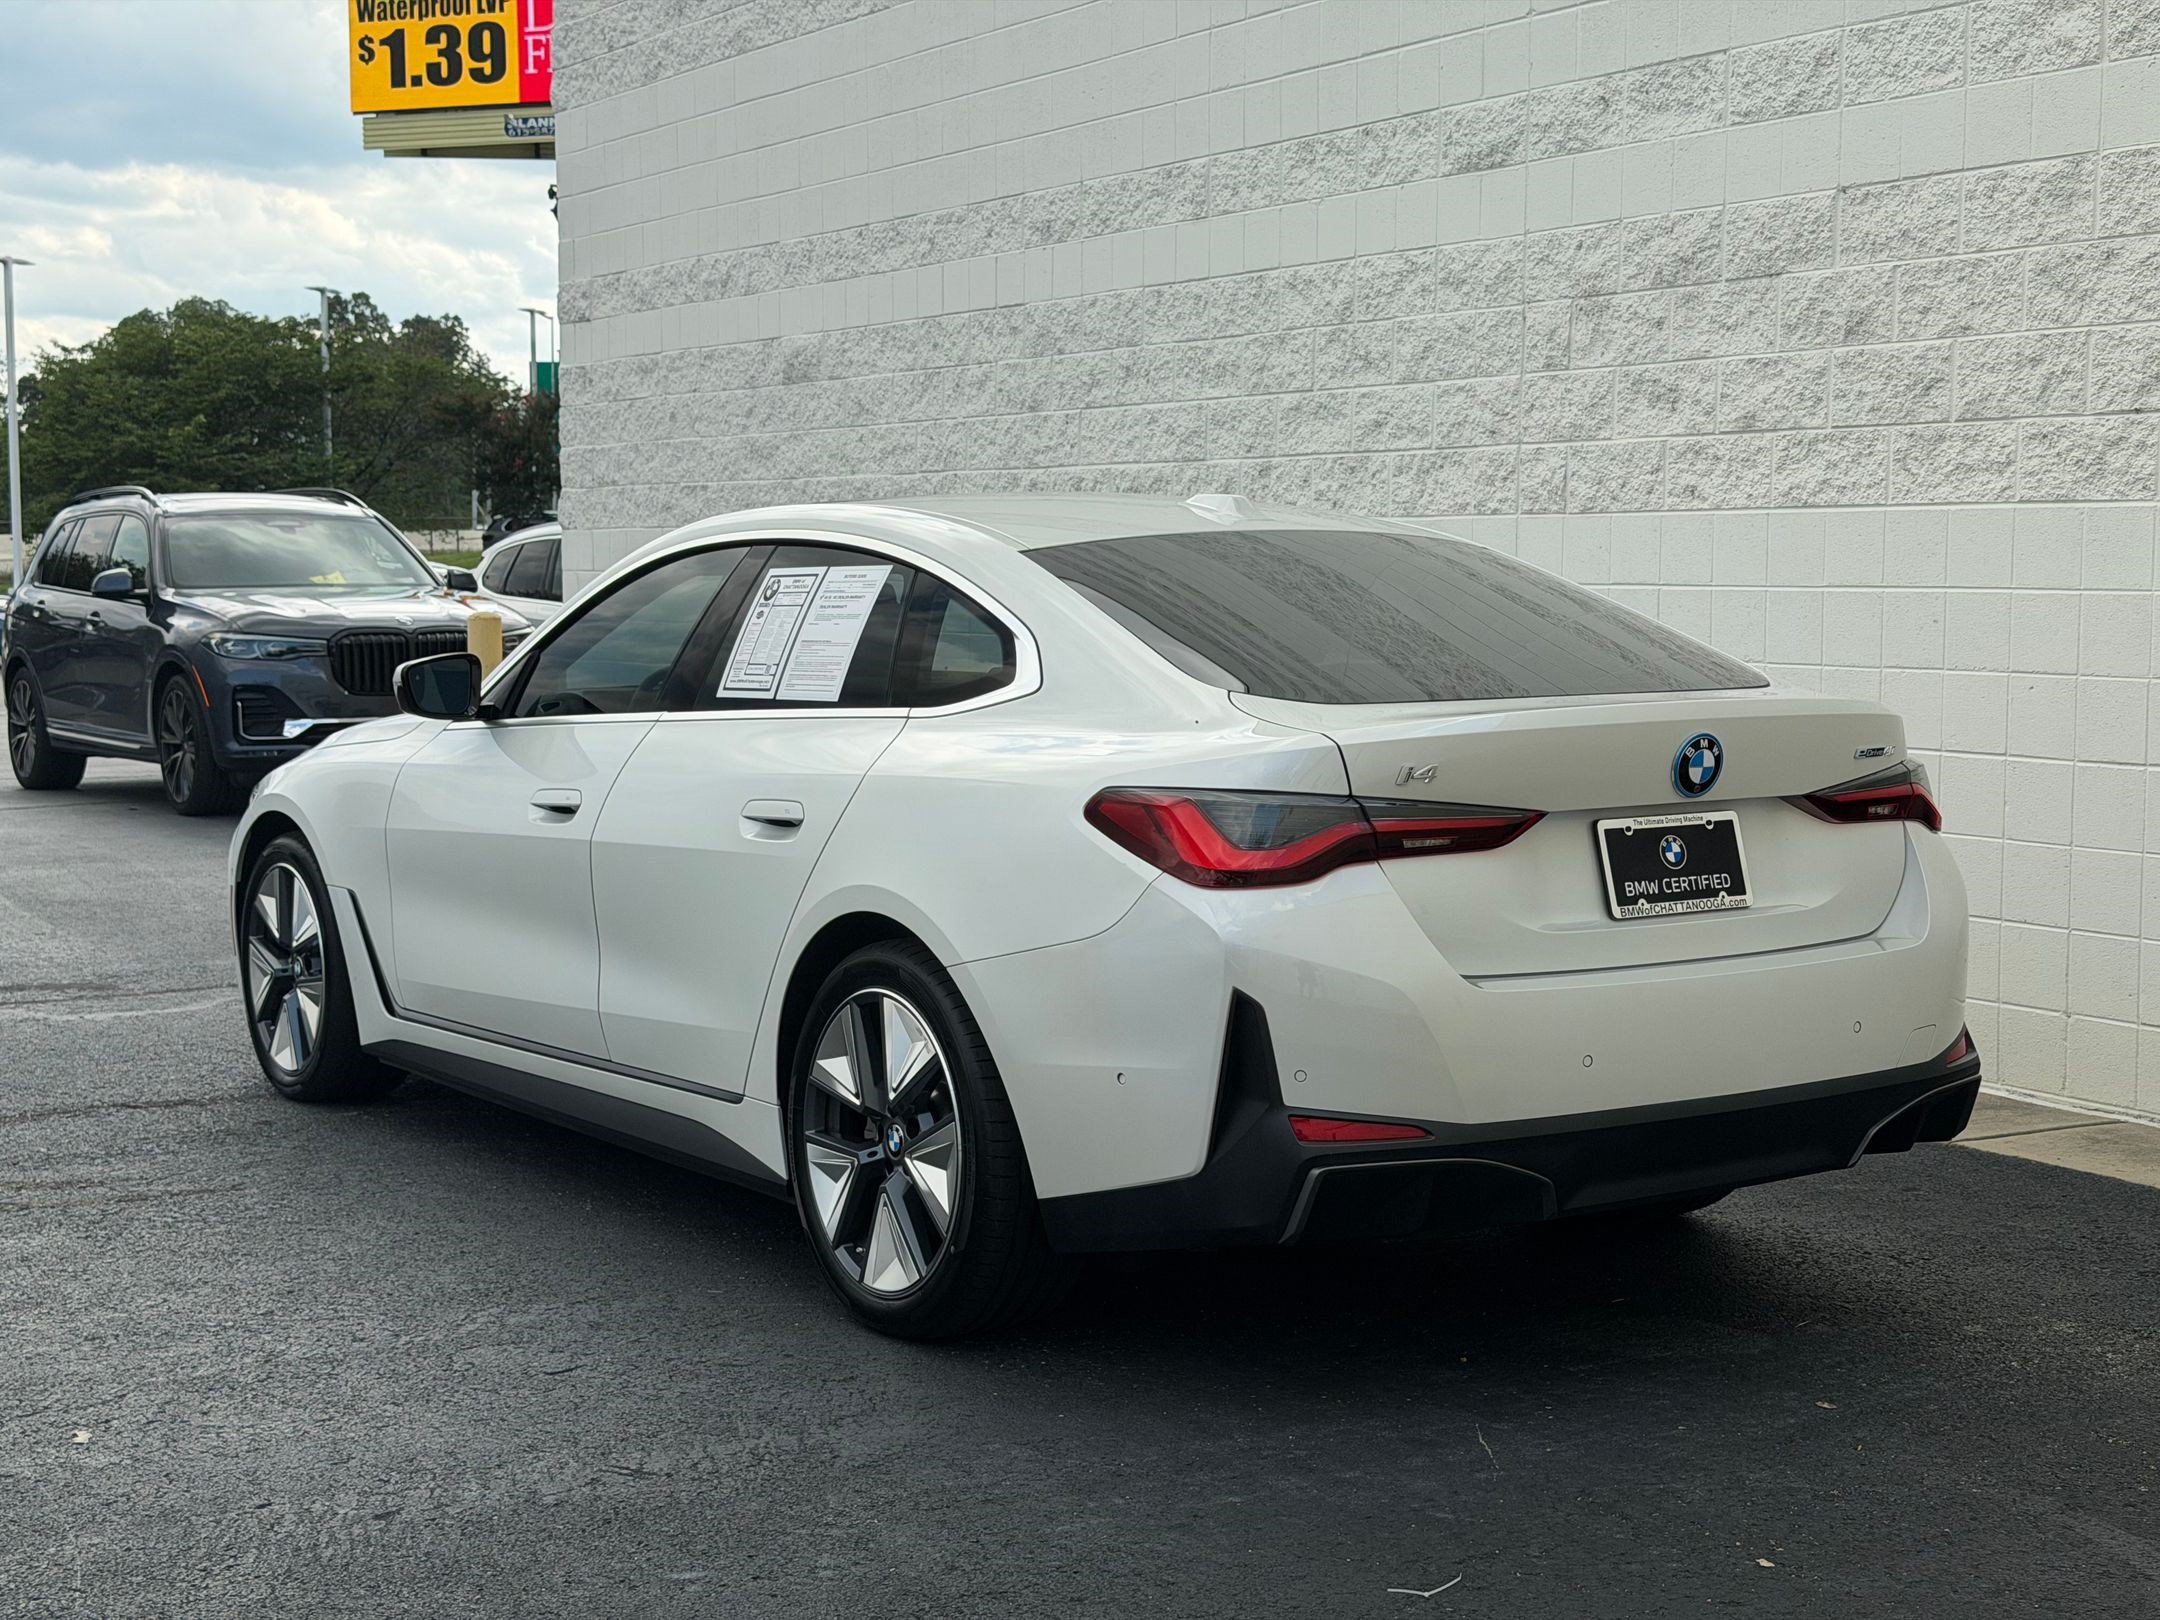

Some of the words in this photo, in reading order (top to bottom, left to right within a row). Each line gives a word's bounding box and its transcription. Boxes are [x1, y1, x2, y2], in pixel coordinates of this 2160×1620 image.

[358, 21, 507, 89] $1.39
[1685, 738, 1720, 758] BMW
[1633, 818, 1643, 827] The
[1644, 816, 1664, 826] Ultimate
[1664, 815, 1682, 826] Driving
[1683, 815, 1703, 824] Machine
[1624, 880, 1658, 897] BMW
[1662, 873, 1731, 893] CERTIFIED
[1620, 898, 1748, 918] BMWofCHATTANOOGA.com
